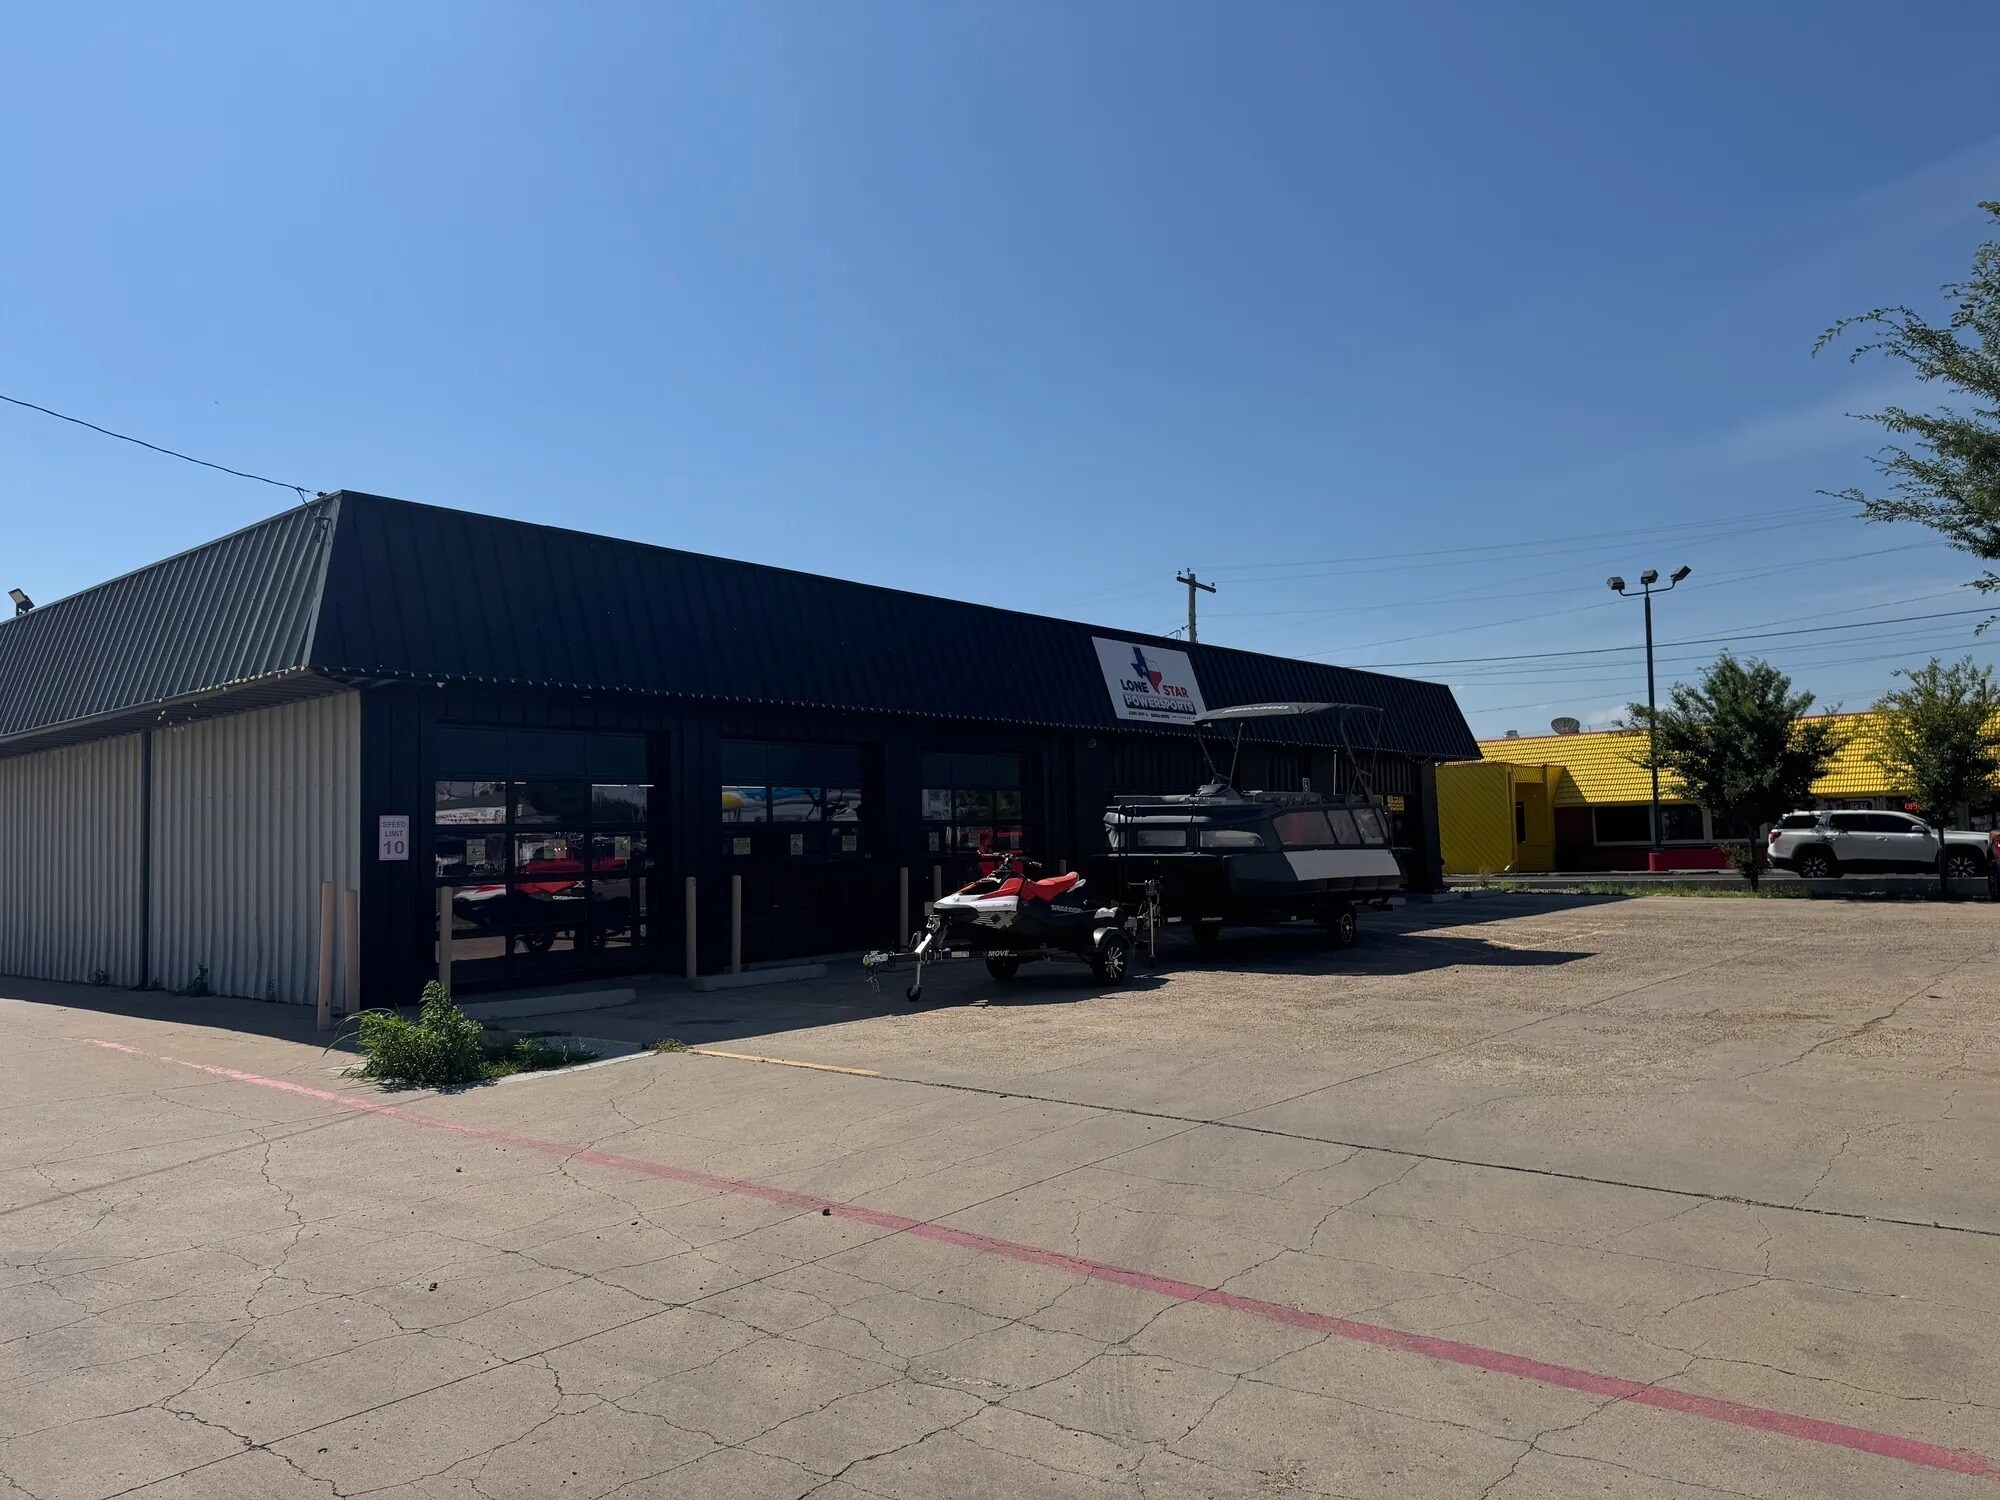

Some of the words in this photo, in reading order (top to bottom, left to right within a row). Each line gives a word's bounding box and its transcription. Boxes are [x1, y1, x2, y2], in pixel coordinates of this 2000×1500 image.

[1120, 679, 1150, 694] LONE
[1162, 685, 1189, 698] STAR
[1125, 695, 1195, 712] POWERSPORTS
[384, 840, 405, 854] 10
